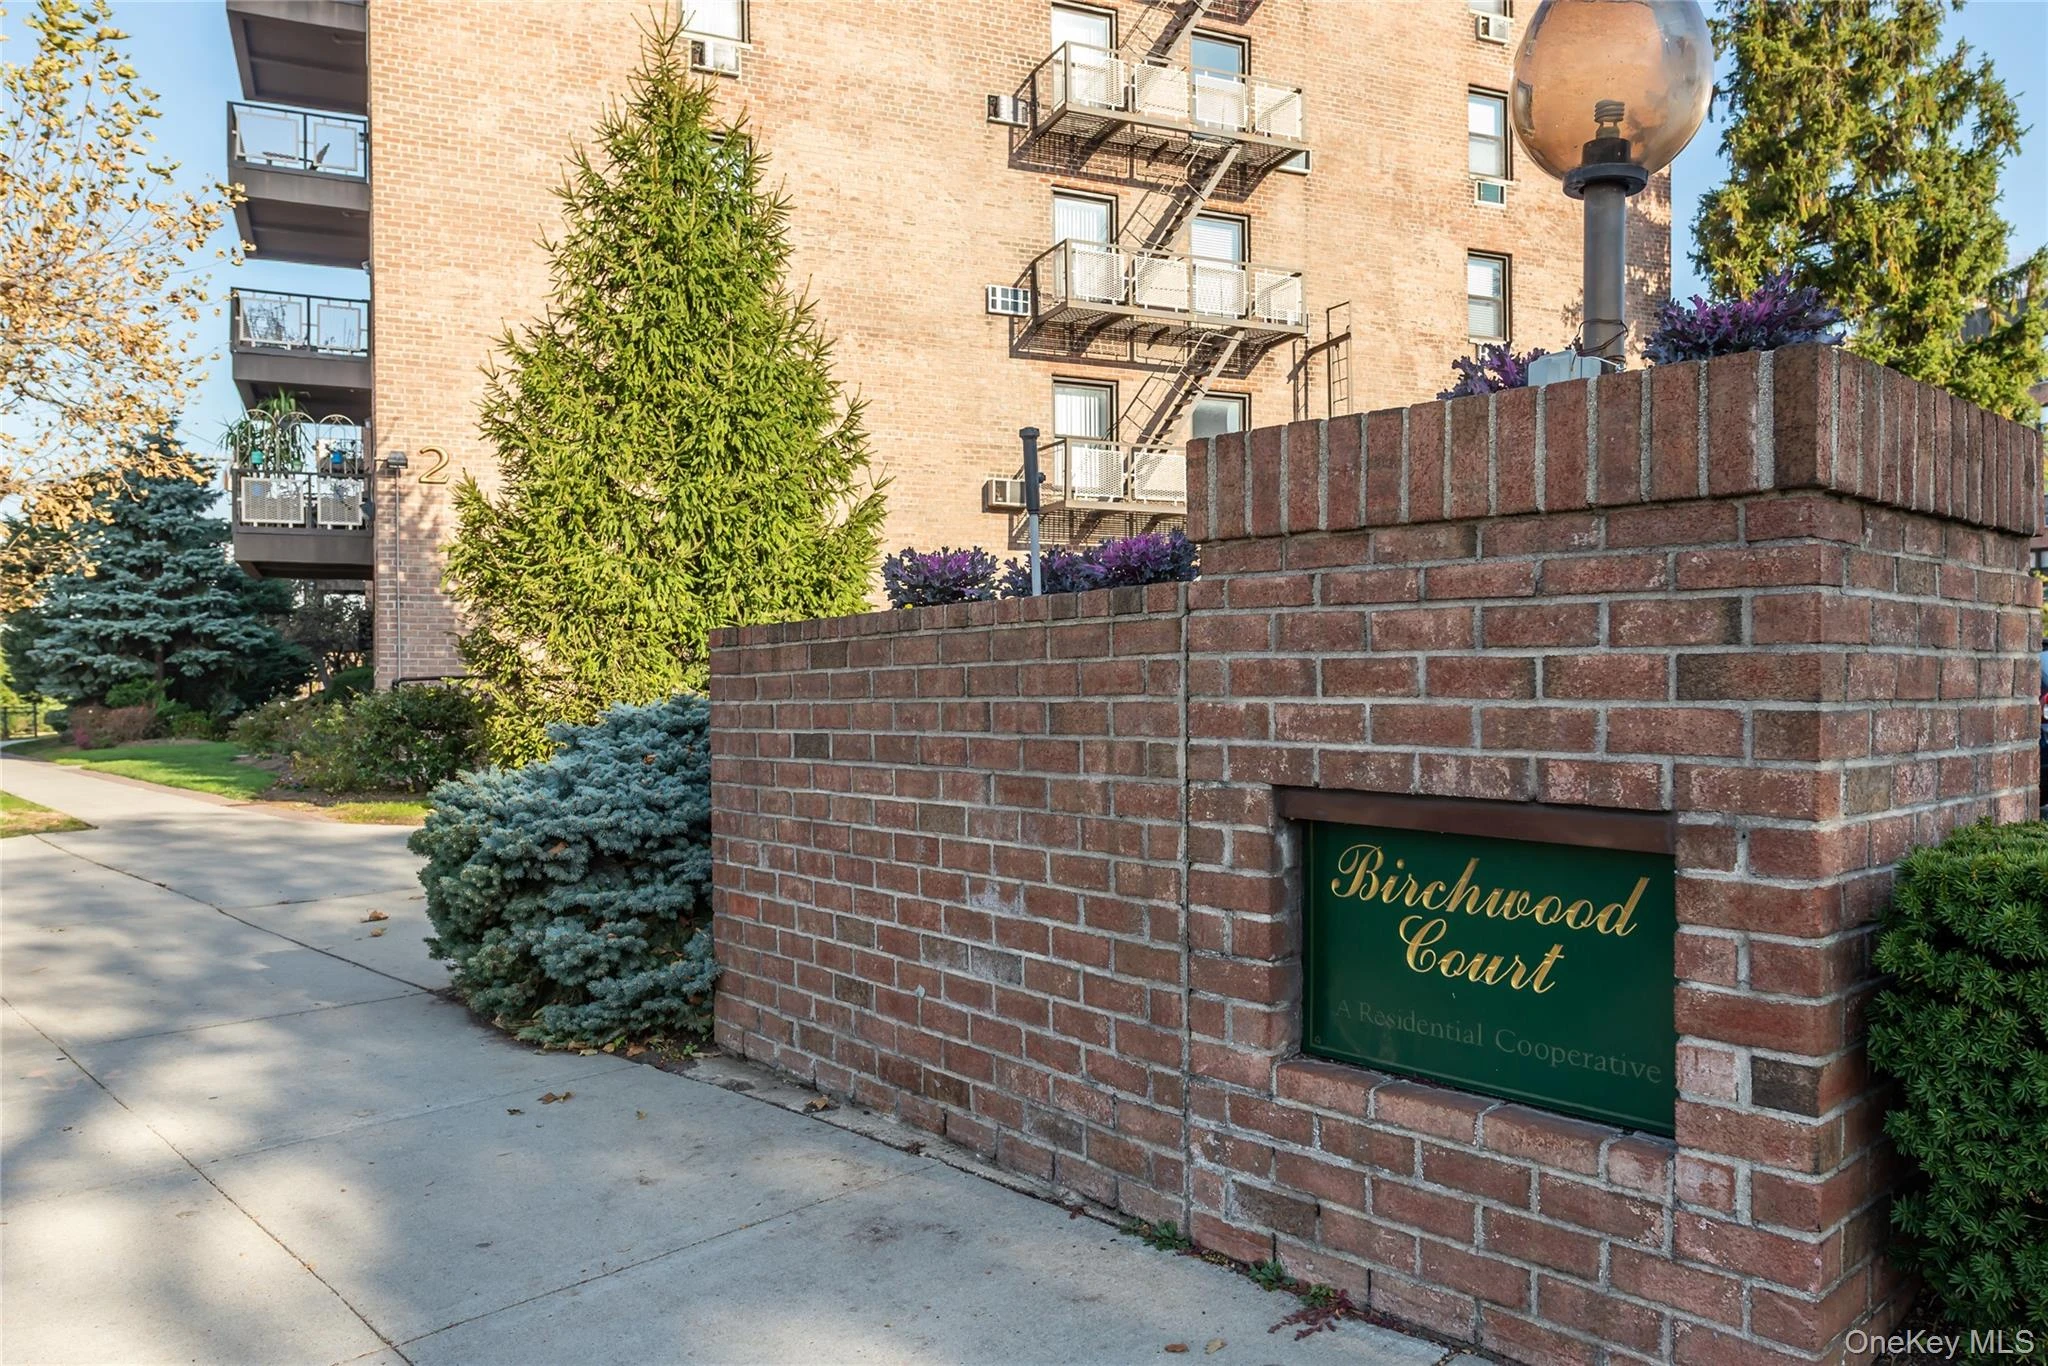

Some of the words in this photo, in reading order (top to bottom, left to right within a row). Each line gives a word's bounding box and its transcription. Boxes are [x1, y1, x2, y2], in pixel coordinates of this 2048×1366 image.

[418, 445, 449, 484] 2
[1331, 843, 1650, 937] Birchwood
[1398, 914, 1565, 994] Court
[1335, 1001, 1353, 1019] A
[1359, 1001, 1484, 1047] Residential
[1495, 1028, 1662, 1084] Cooperative
